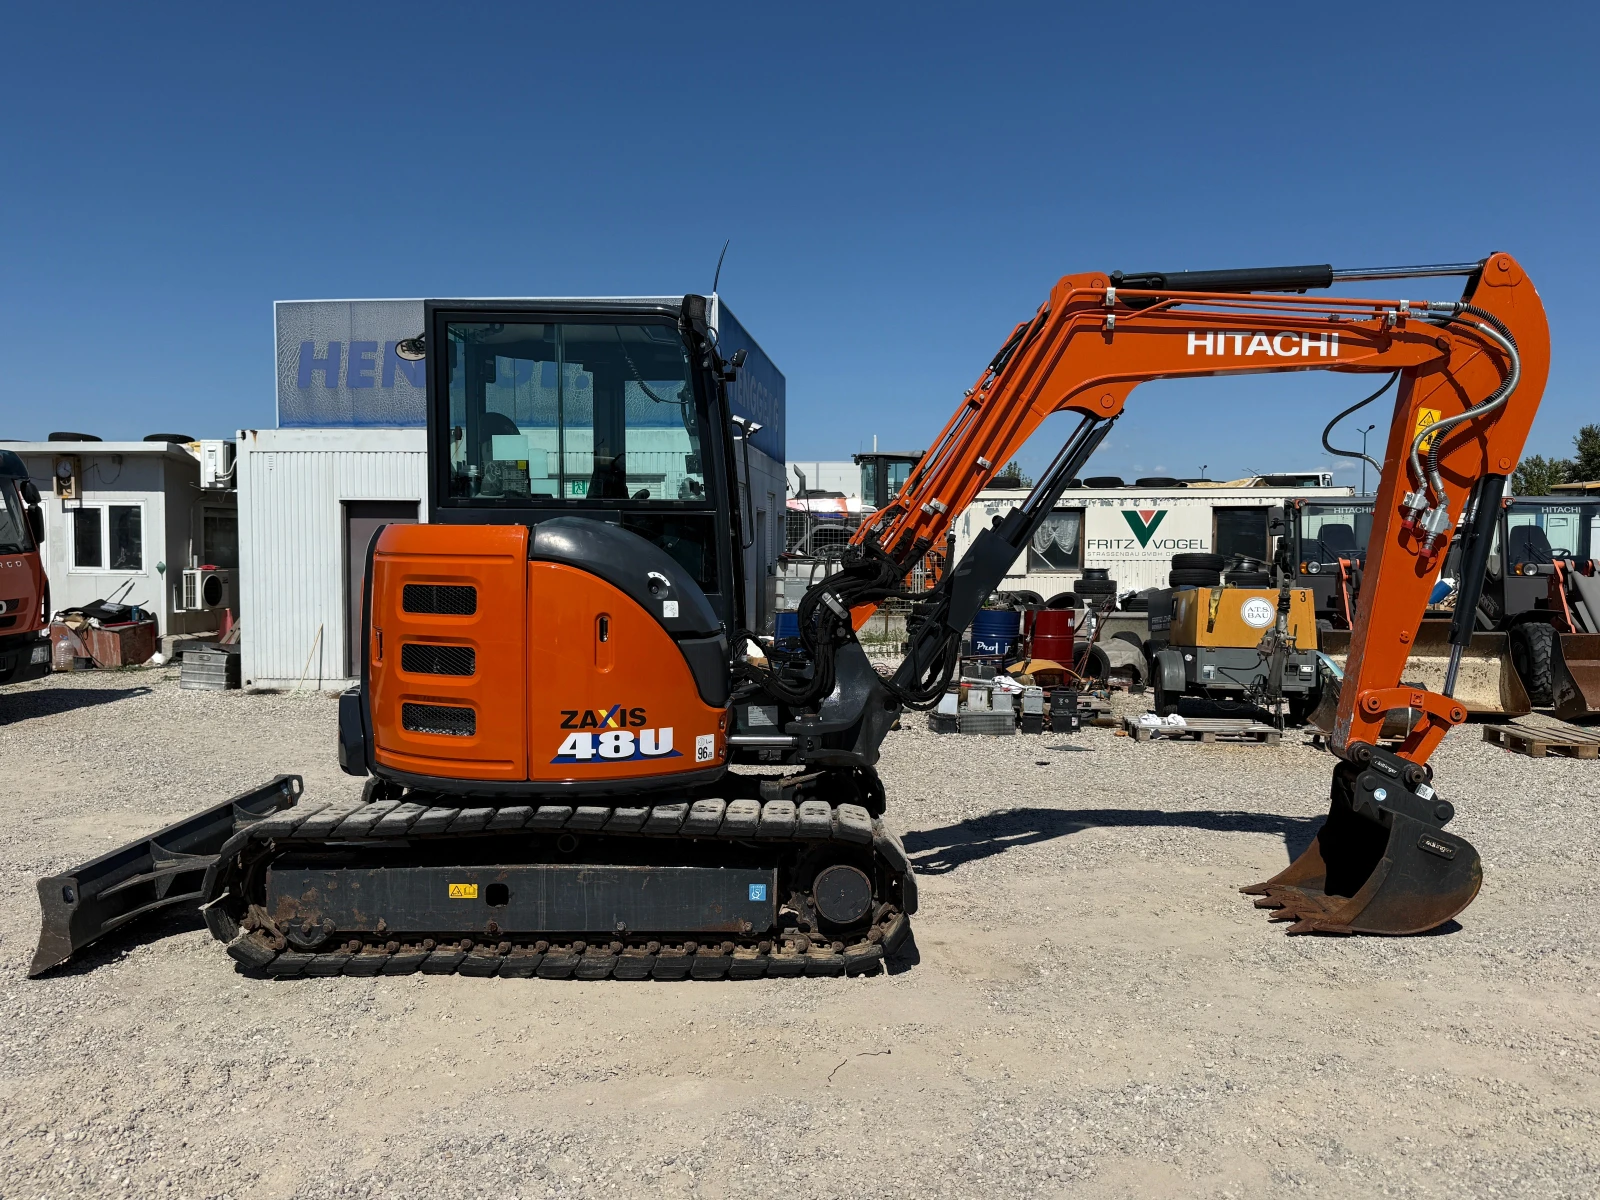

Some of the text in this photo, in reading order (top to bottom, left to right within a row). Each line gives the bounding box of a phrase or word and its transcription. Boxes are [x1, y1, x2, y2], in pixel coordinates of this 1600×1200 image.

[1187, 331, 1339, 357] HITACHI
[1541, 506, 1581, 514] HITACHI
[1087, 539, 1209, 549] FRITZ VOGEL
[1300, 591, 1306, 603] 3
[560, 704, 647, 728] ZAXIS
[557, 727, 674, 761] 48U
[697, 746, 708, 760] 96
